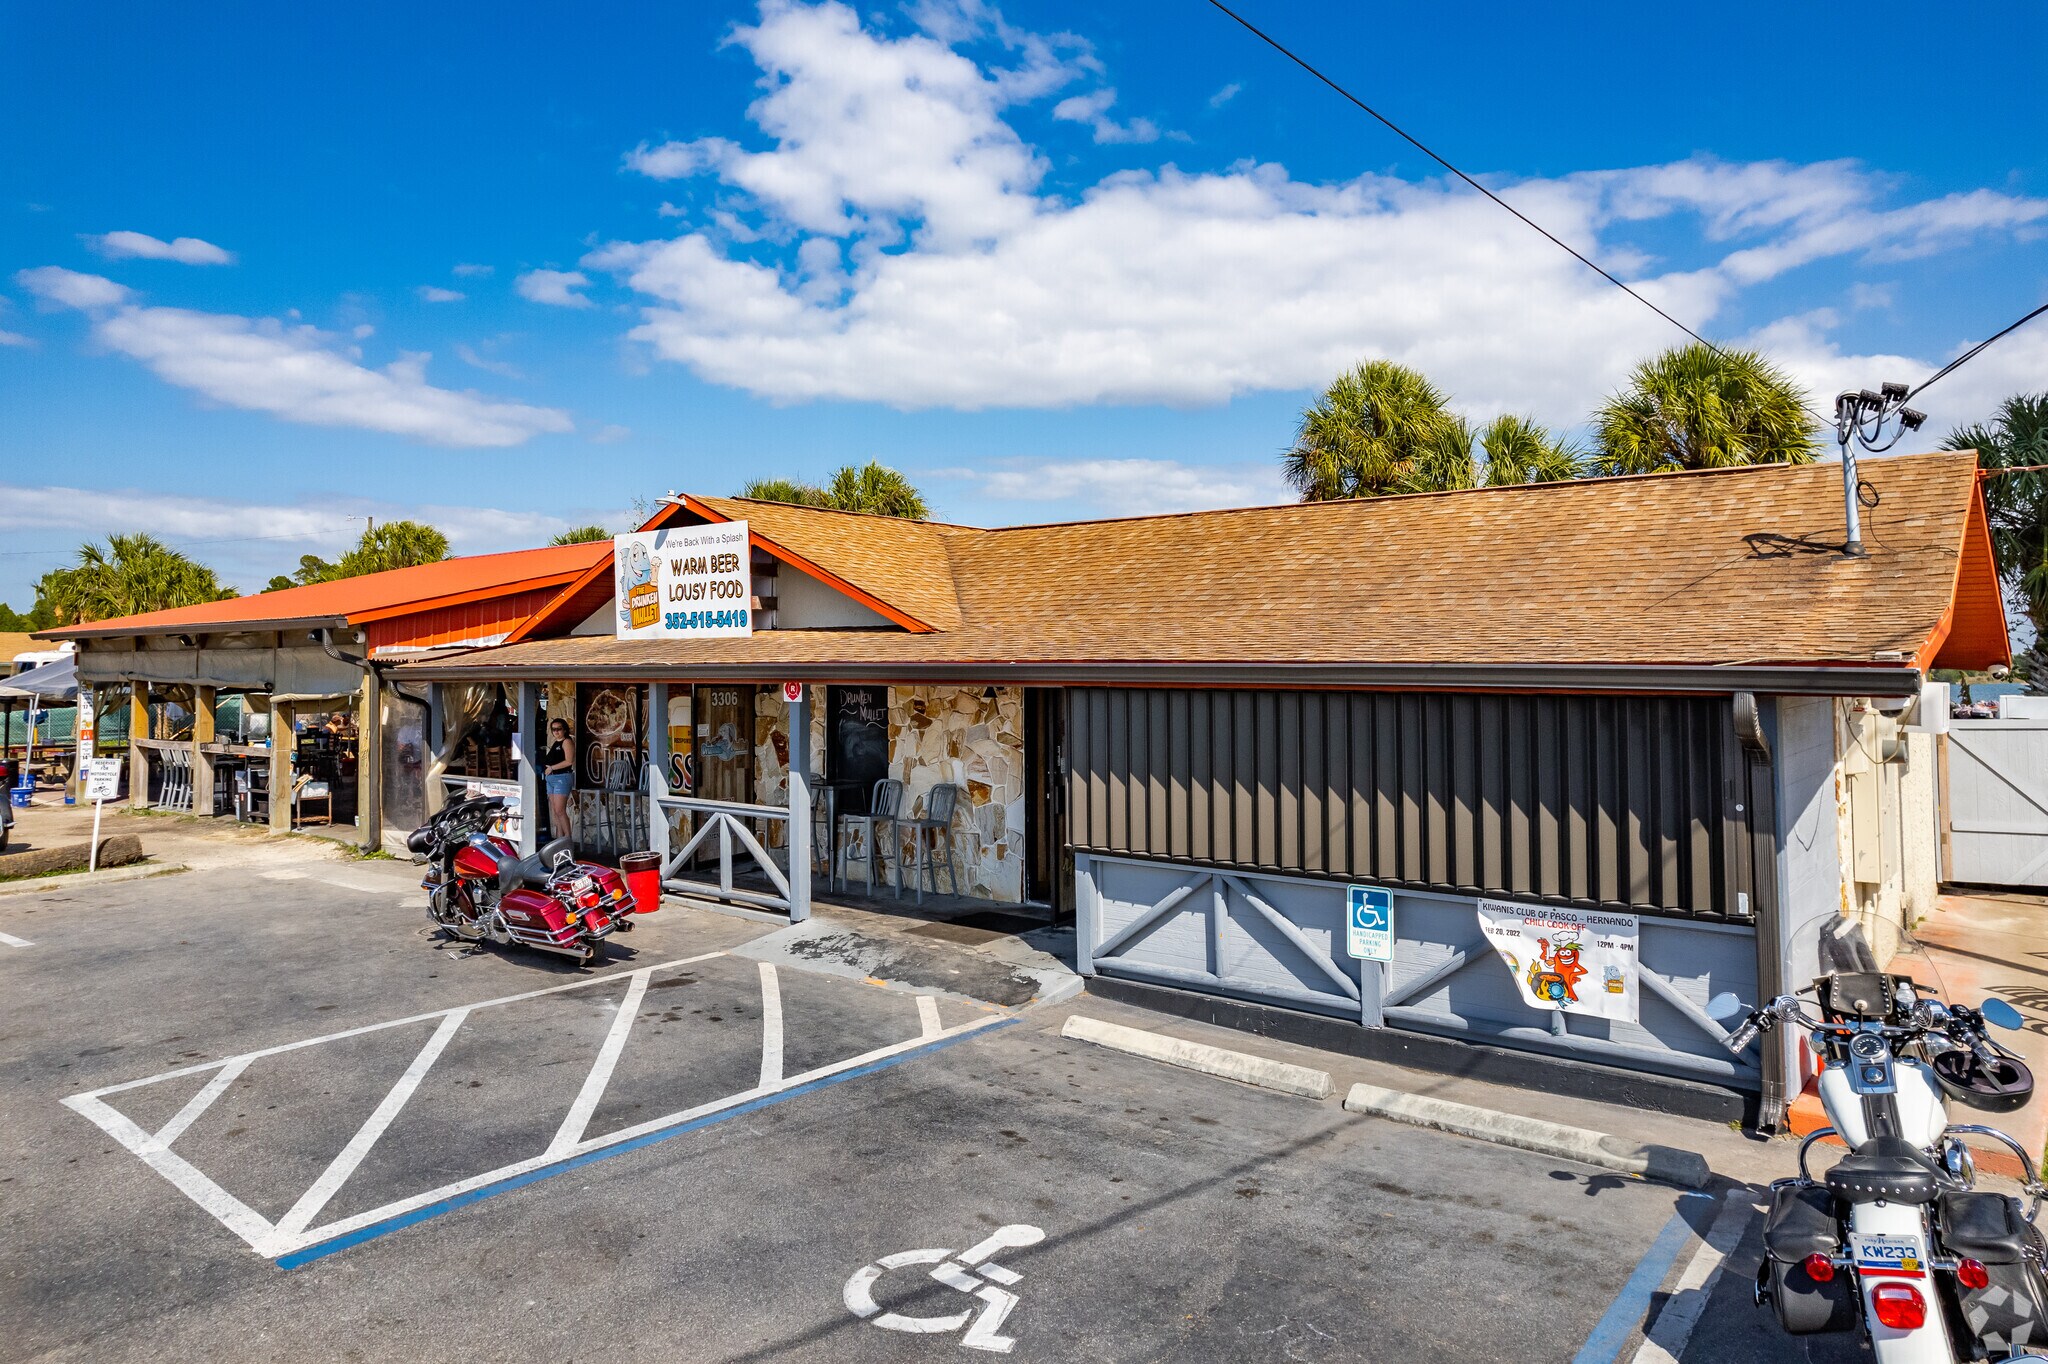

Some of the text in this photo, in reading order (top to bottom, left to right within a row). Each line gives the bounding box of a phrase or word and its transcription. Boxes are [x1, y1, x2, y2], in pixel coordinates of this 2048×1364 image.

[666, 540, 683, 549] We're
[684, 538, 700, 546] Back
[700, 536, 714, 545] With
[722, 533, 743, 544] Splash
[671, 553, 740, 576] WARM BEER
[669, 580, 743, 602] LOUSY FOOD
[632, 592, 658, 608] DRUNKEN
[632, 604, 658, 626] MULLET
[665, 610, 747, 630] 352-515-5419
[712, 692, 738, 706] 3306
[840, 689, 872, 707] DRUNKEN
[860, 706, 887, 721] MULLET
[1482, 903, 1514, 914] KIWANIS
[1516, 908, 1535, 917] CLUB
[1550, 912, 1577, 922] PASCO
[1587, 916, 1633, 927] HERNANDO
[1524, 918, 1544, 927] CHILI
[1547, 920, 1569, 929] COOK
[1352, 930, 1388, 940] HANDICAPPED
[1359, 939, 1381, 947] PARKING
[1597, 941, 1614, 949] 12PM
[1862, 1245, 1917, 1258] KW233
